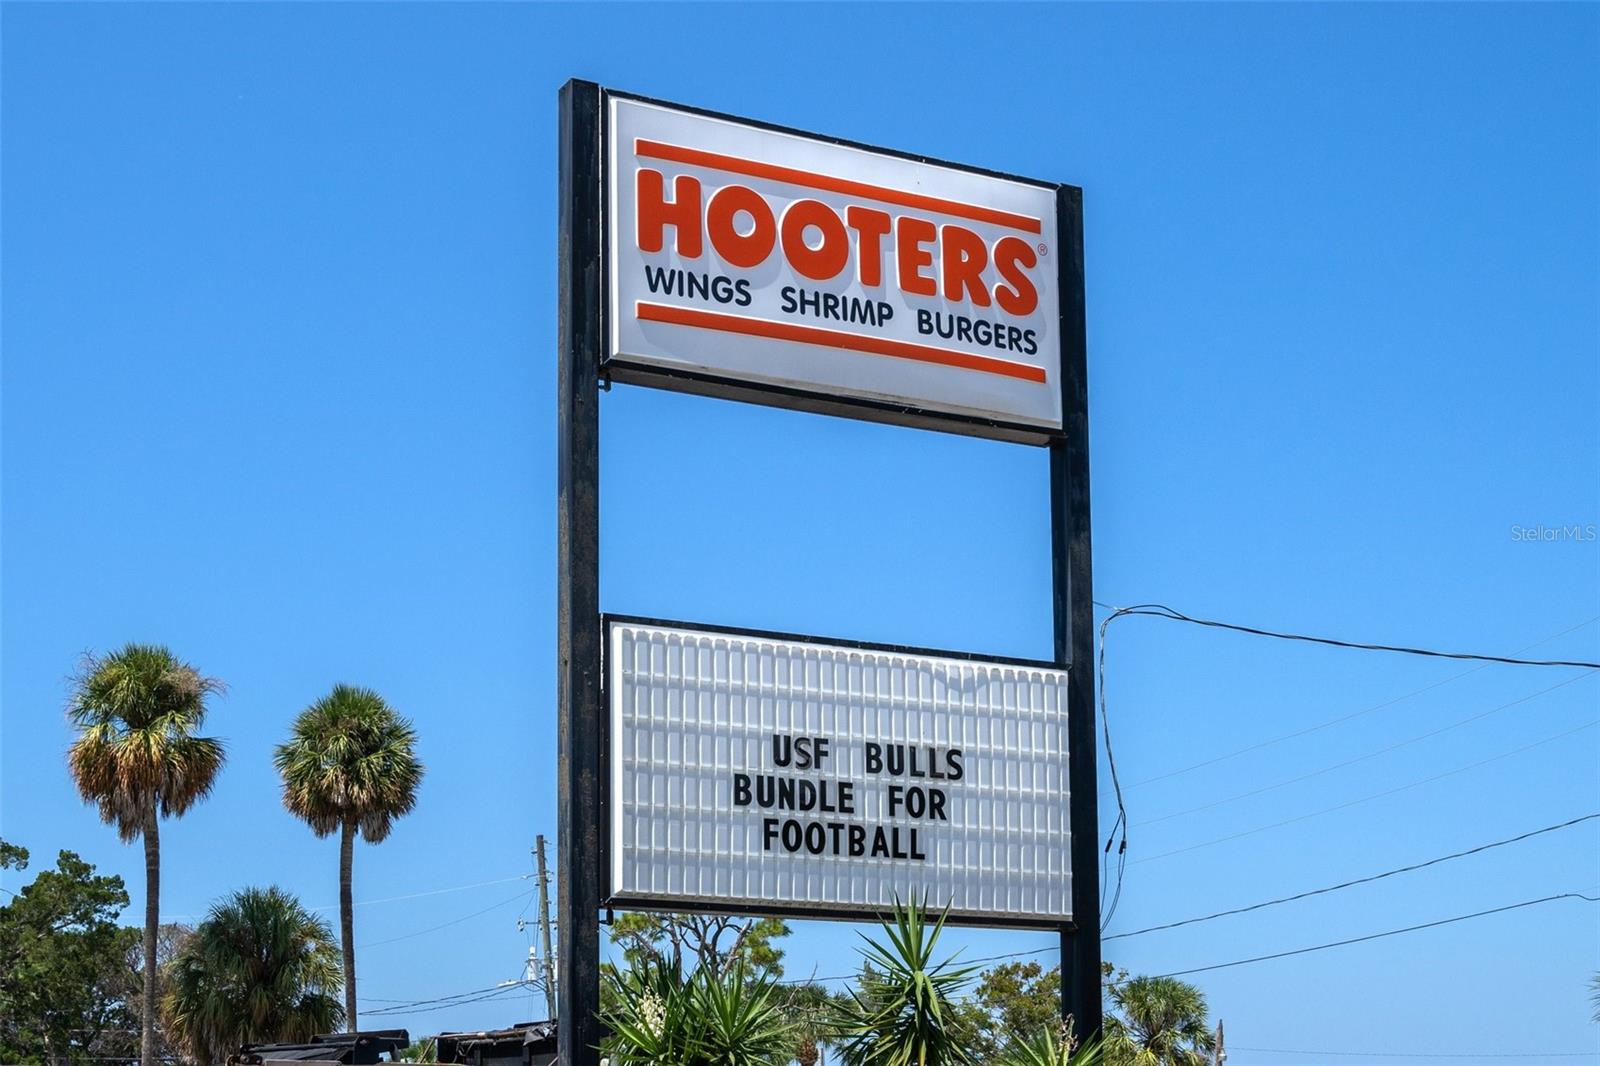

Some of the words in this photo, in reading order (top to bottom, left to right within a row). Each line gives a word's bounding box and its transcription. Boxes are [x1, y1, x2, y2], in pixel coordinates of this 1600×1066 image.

[637, 168, 1038, 316] HOOTERS
[645, 265, 752, 307] WINGS
[781, 286, 894, 327] SHRIMP
[918, 309, 1038, 356] BURGERS
[773, 734, 830, 770] USF
[866, 742, 963, 781] BULLS
[734, 773, 855, 813] BUNDLE
[888, 785, 947, 821] FOR
[763, 818, 926, 860] FOOTBALL
